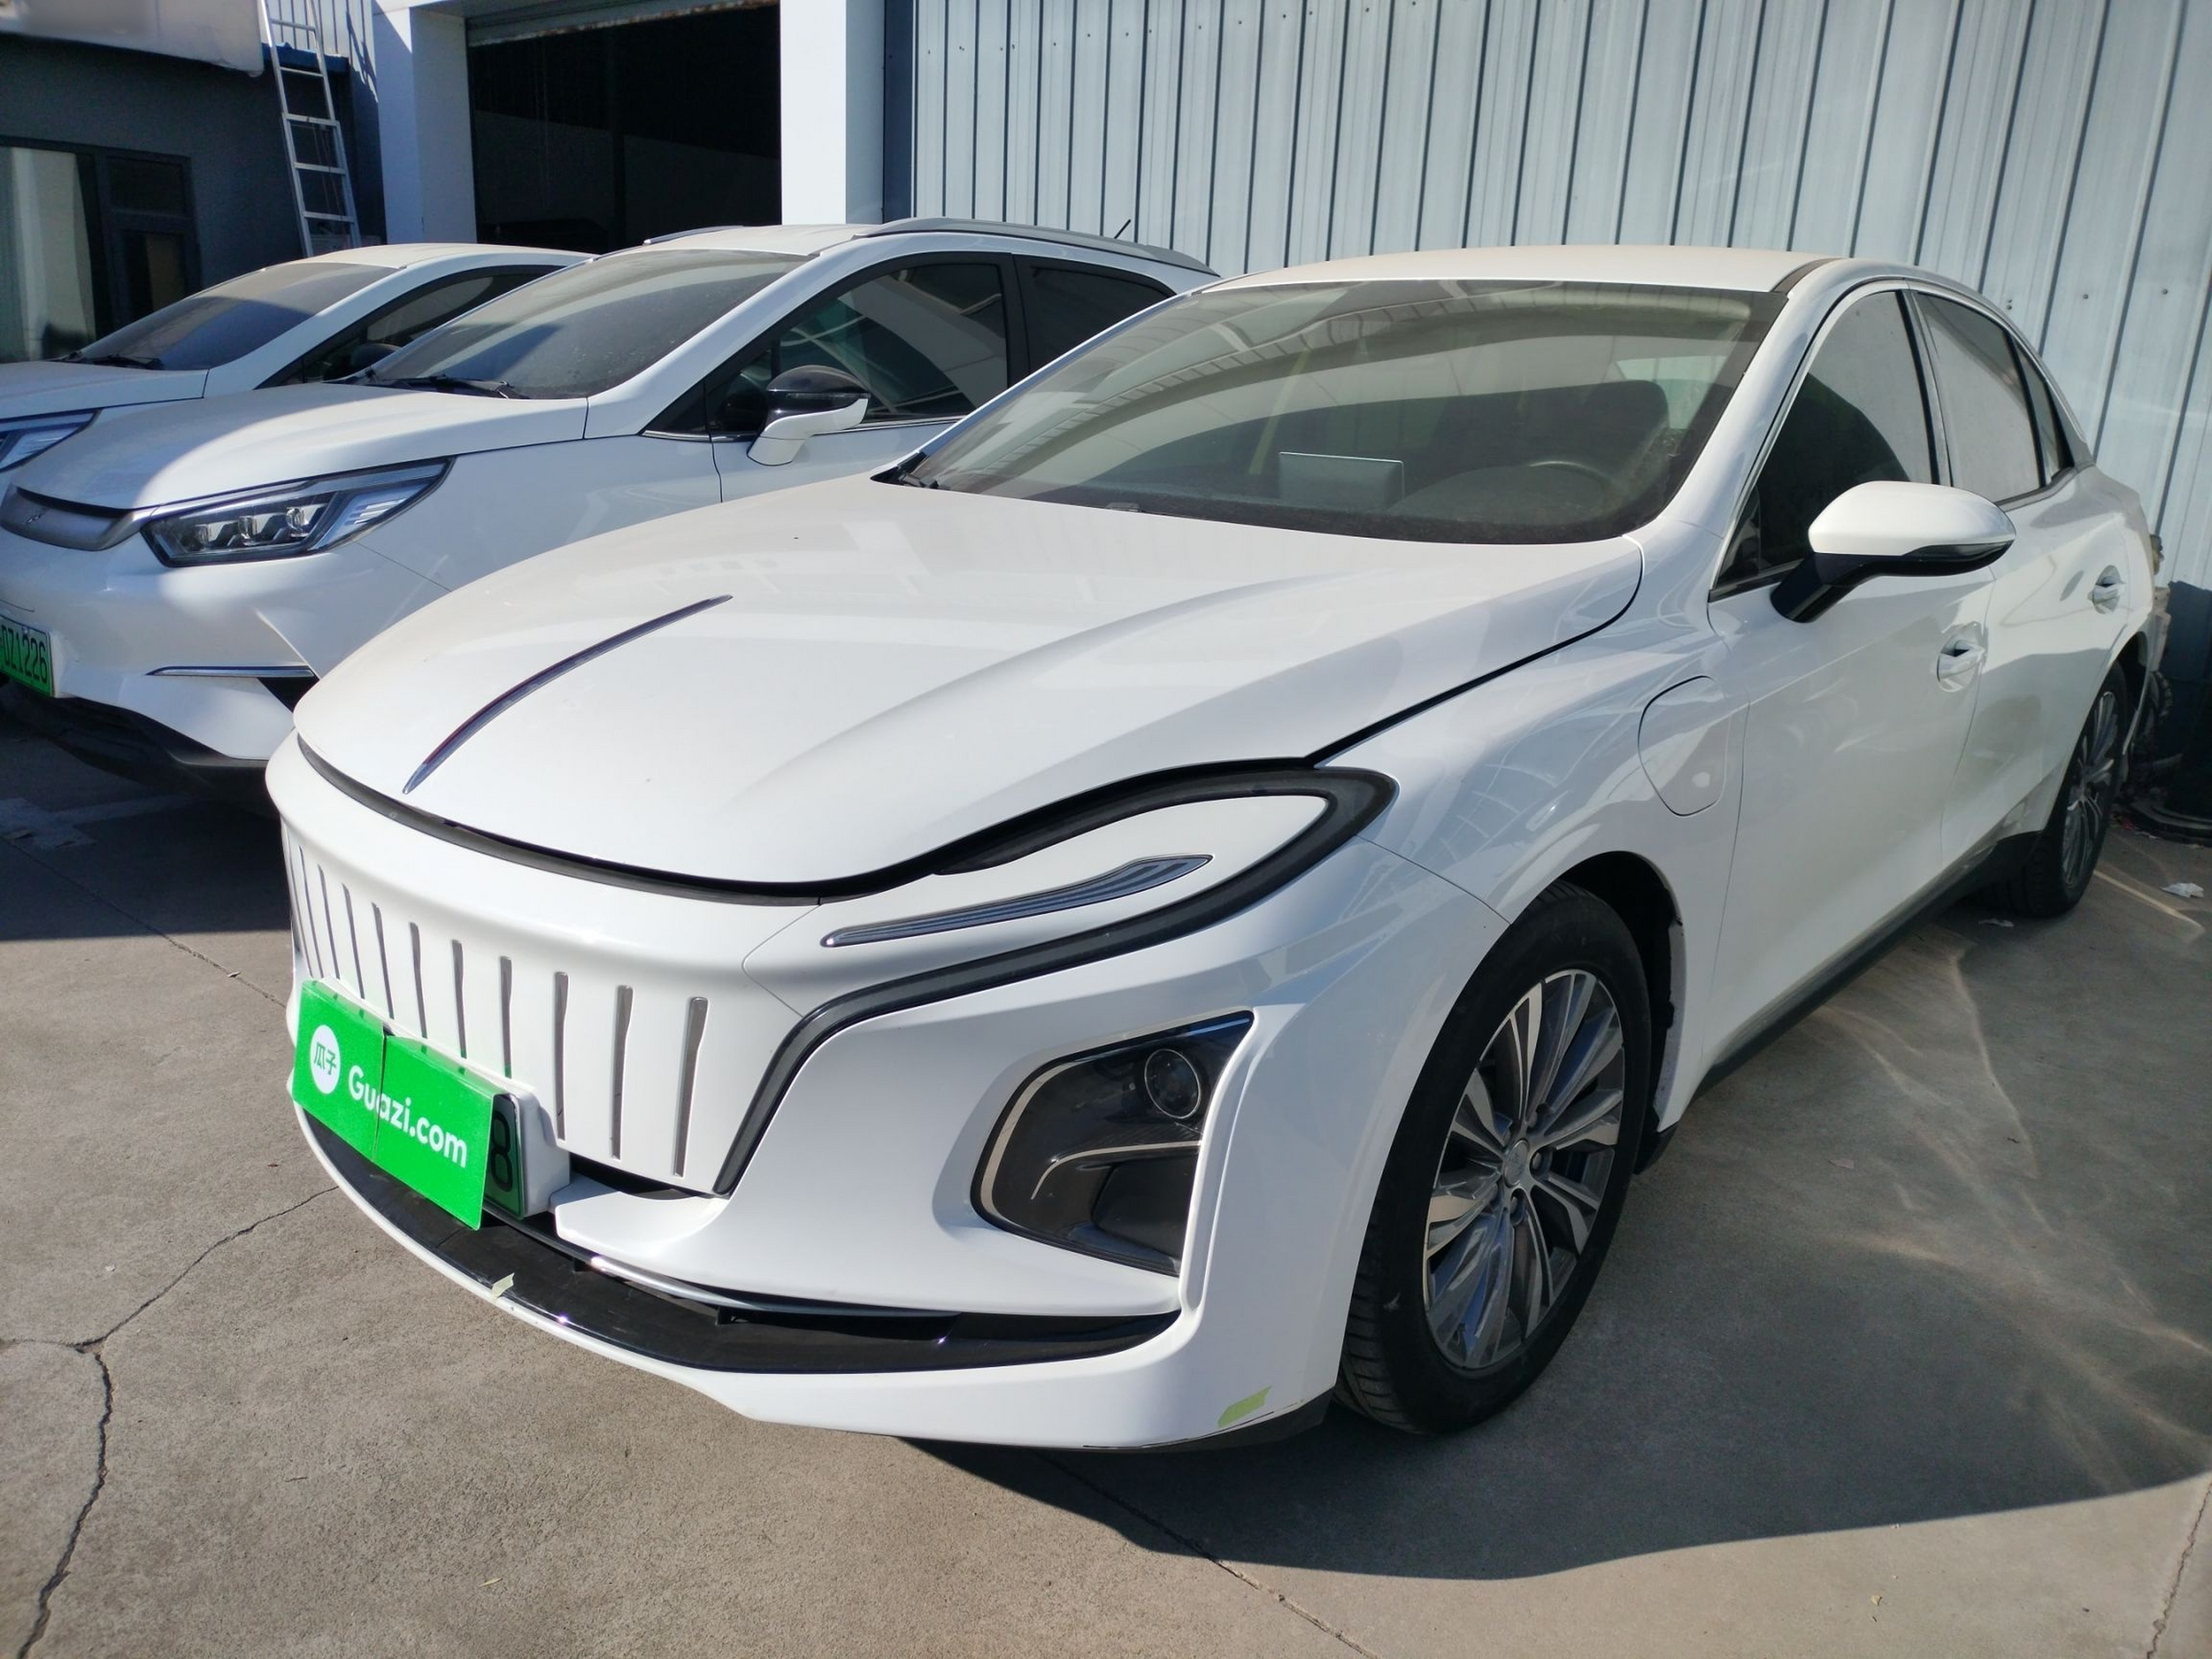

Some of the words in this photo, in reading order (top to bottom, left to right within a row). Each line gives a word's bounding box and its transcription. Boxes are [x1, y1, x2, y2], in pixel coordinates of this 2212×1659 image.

[314, 1041, 337, 1075] 瓜子
[349, 1065, 468, 1168] Guazi.com
[491, 1111, 513, 1192] 8
